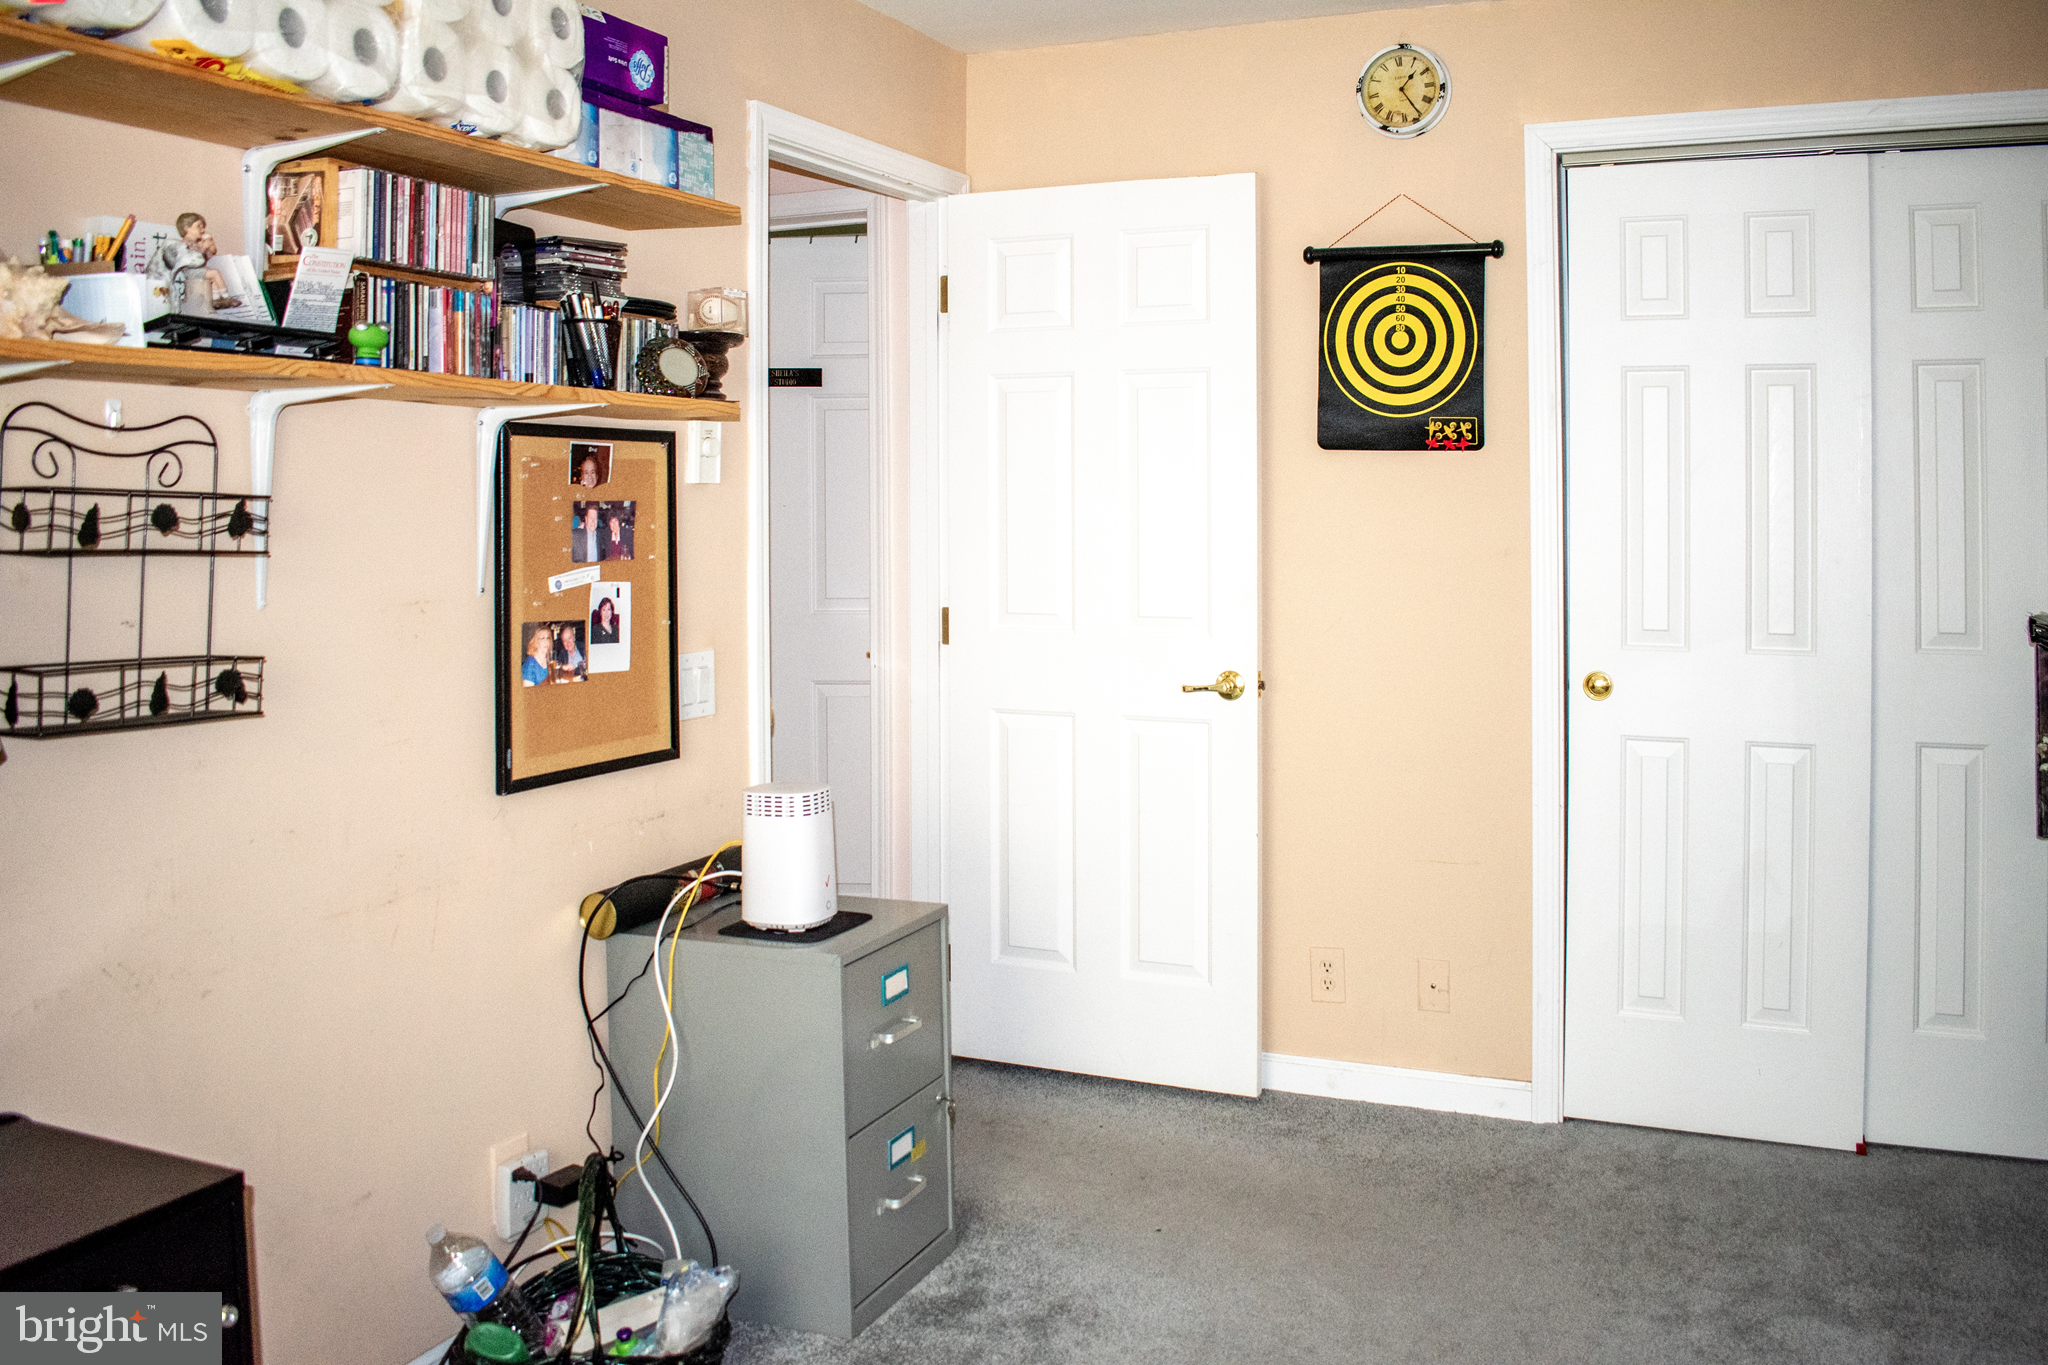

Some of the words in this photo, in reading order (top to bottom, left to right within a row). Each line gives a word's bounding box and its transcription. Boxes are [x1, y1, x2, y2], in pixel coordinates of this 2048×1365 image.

[633, 57, 651, 83] Puffs
[303, 255, 346, 269] CONSTITUTION
[1396, 266, 1406, 274] 10
